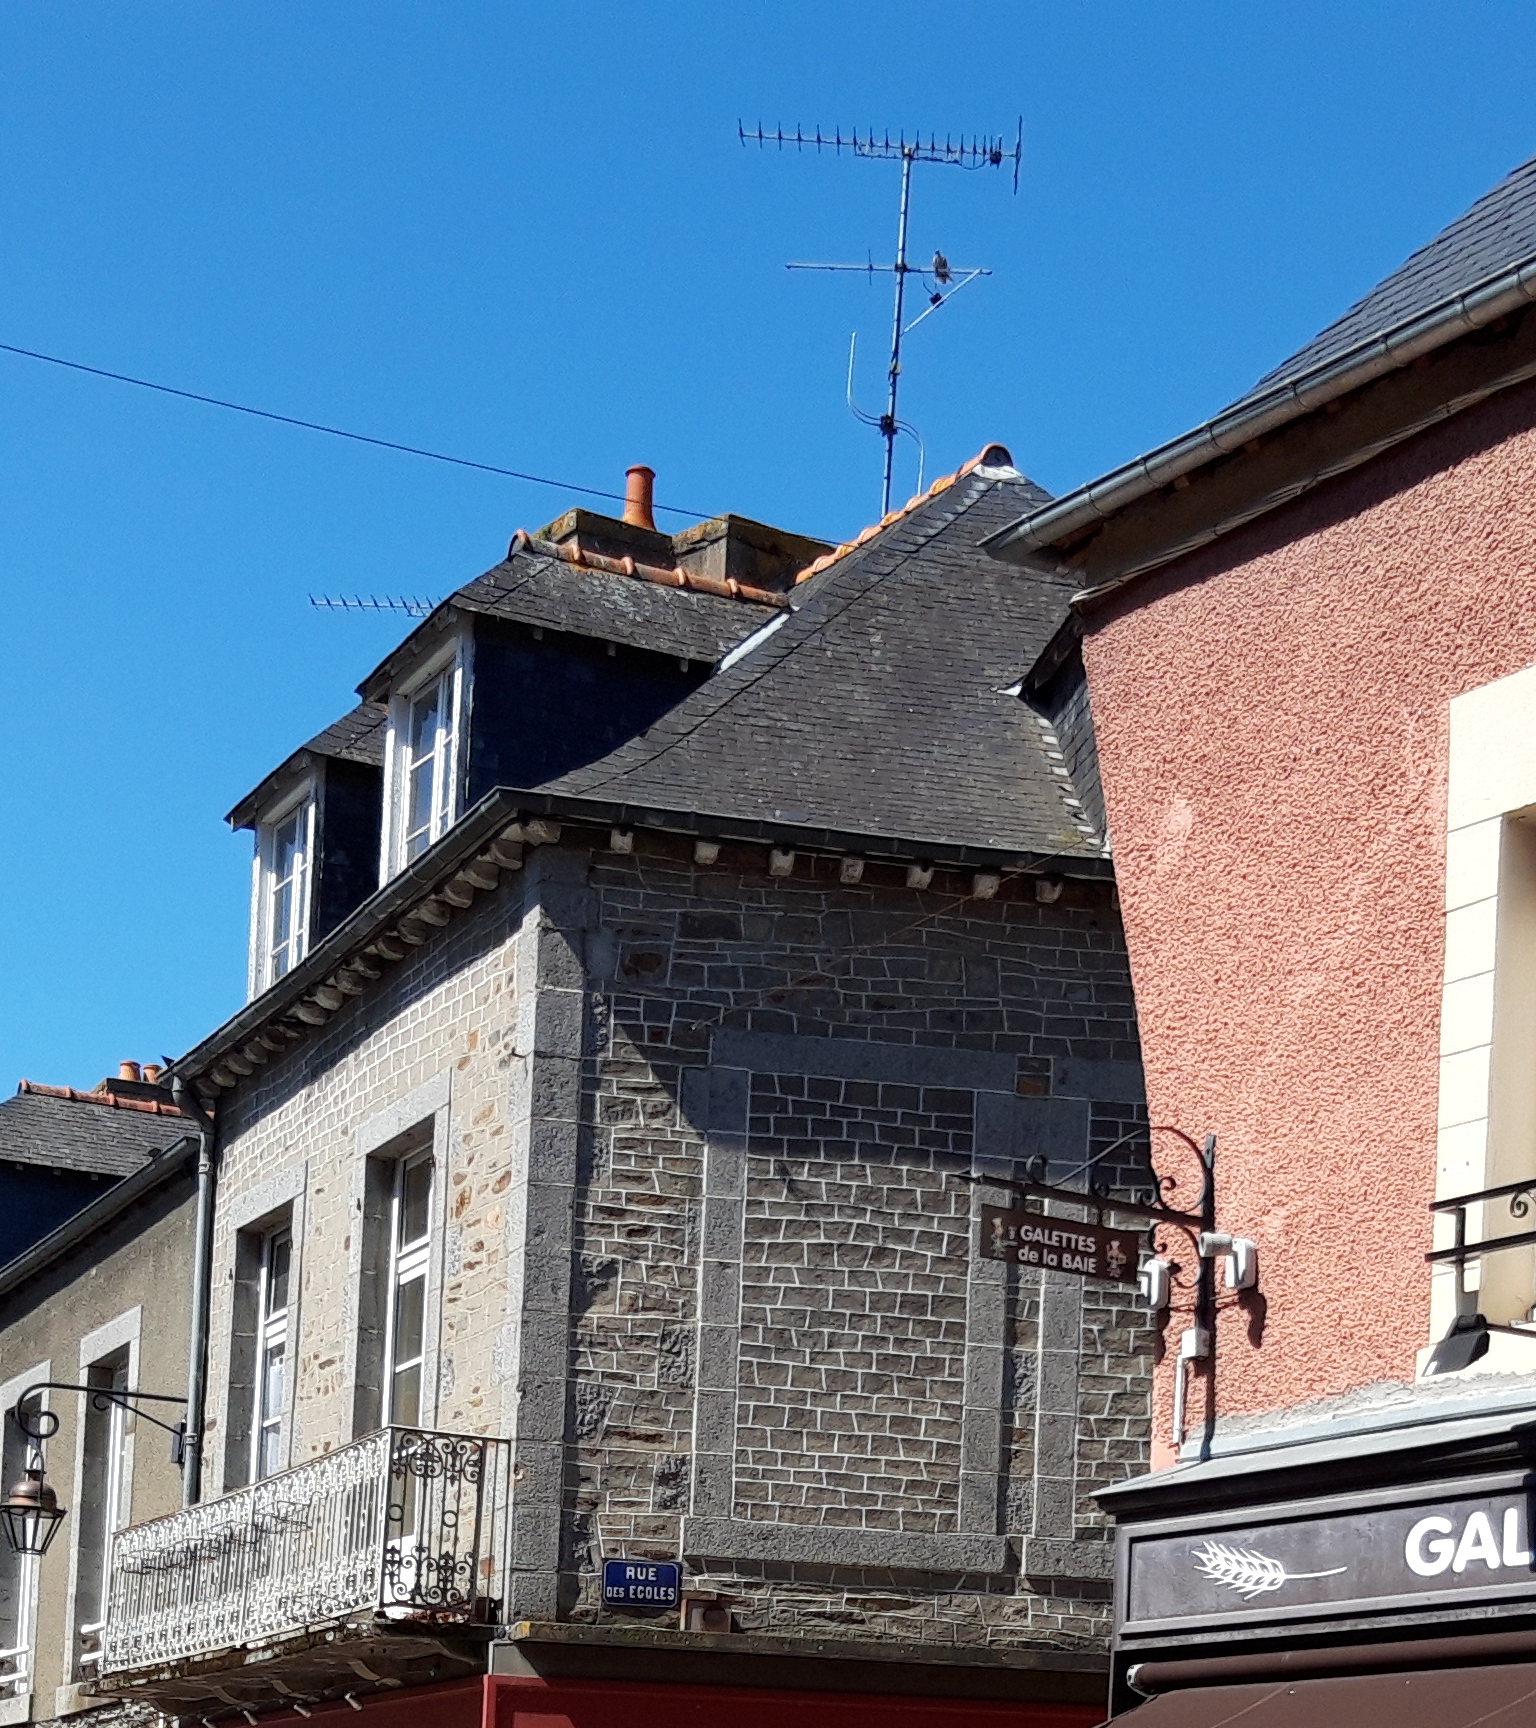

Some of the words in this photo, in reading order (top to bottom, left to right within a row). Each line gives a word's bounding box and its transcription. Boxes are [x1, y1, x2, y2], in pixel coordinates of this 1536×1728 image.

[1020, 1225, 1096, 1252] GALETTES
[1018, 1246, 1038, 1262] de
[1043, 1248, 1058, 1266] la
[1062, 1254, 1097, 1273] BAIE
[626, 1566, 657, 1581] RUE
[606, 1586, 625, 1598] DES
[629, 1585, 675, 1600] ECOLES
